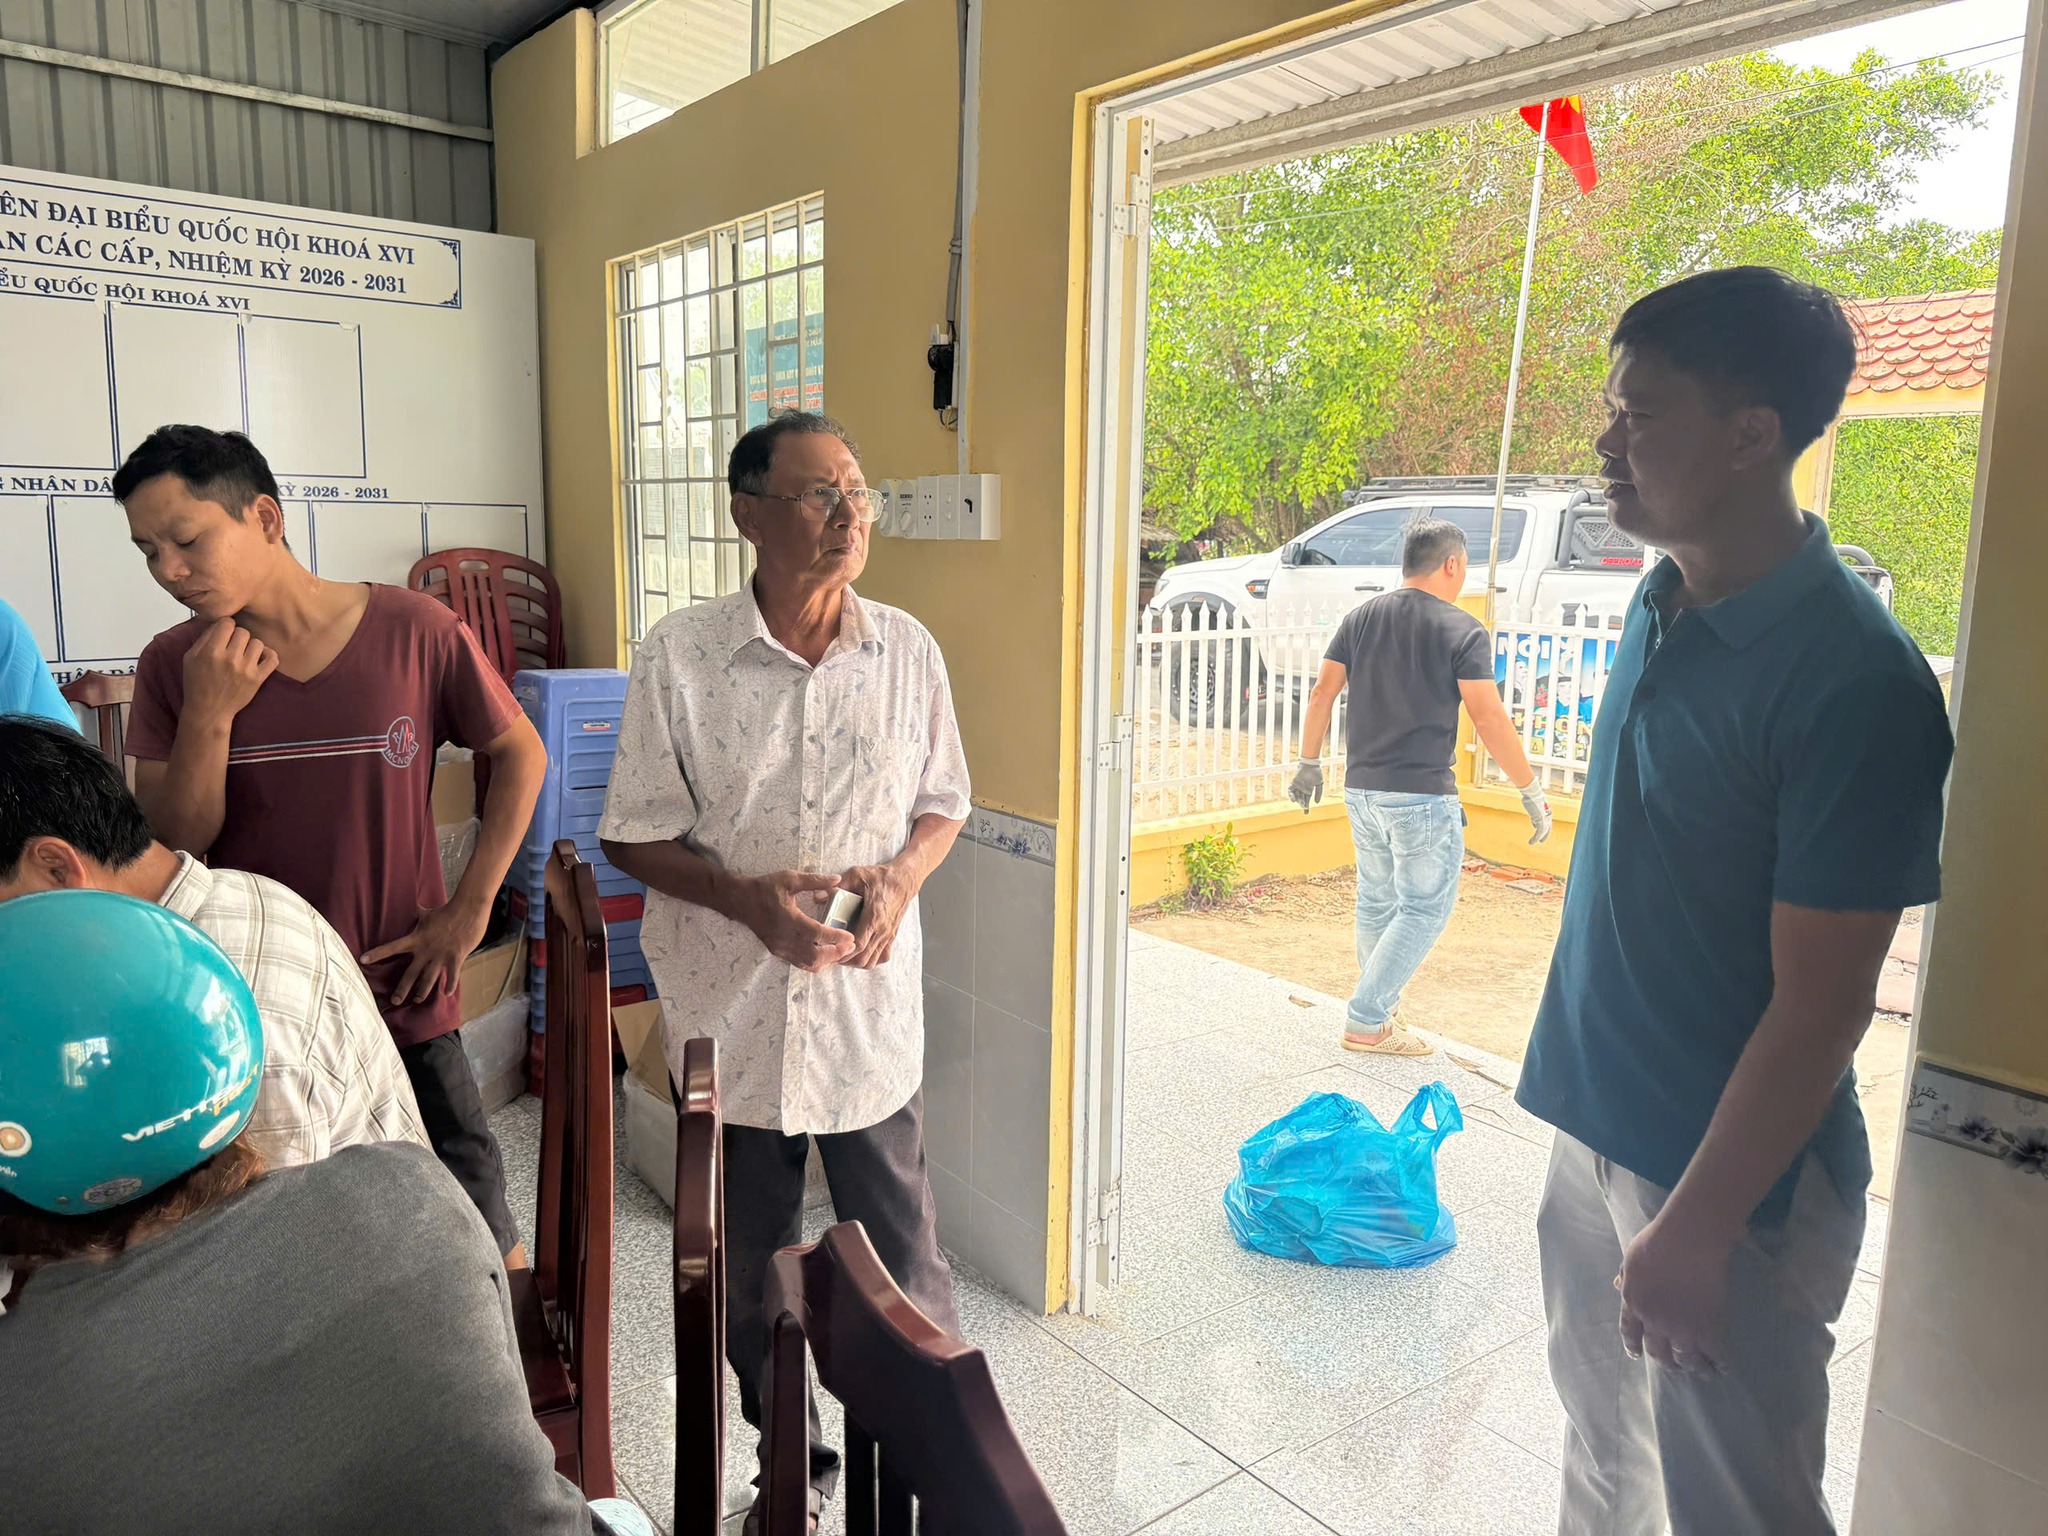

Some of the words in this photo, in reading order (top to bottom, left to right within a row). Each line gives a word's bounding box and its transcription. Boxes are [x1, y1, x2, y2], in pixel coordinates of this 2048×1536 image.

[47, 201, 98, 229] ĐẠI
[105, 204, 170, 235] BIỂU
[178, 216, 248, 244] QUỐC
[256, 226, 300, 254] HỘI
[307, 235, 371, 260] KHOÁ
[378, 244, 415, 265] XVI
[36, 232, 92, 258] CÁC
[101, 237, 161, 270] CẤP,
[168, 249, 253, 279] NHIỆM
[260, 257, 292, 281] KỲ
[300, 266, 345, 287] 2026
[364, 273, 406, 293] 2031
[34, 276, 98, 296] QUỐC
[105, 283, 145, 301] HỘI
[151, 288, 211, 307] KHOÁ
[216, 295, 250, 310] XVI
[11, 475, 77, 491] NHÂN
[83, 476, 114, 492] DÂ
[303, 485, 339, 497] 2026
[355, 487, 389, 498] 2031
